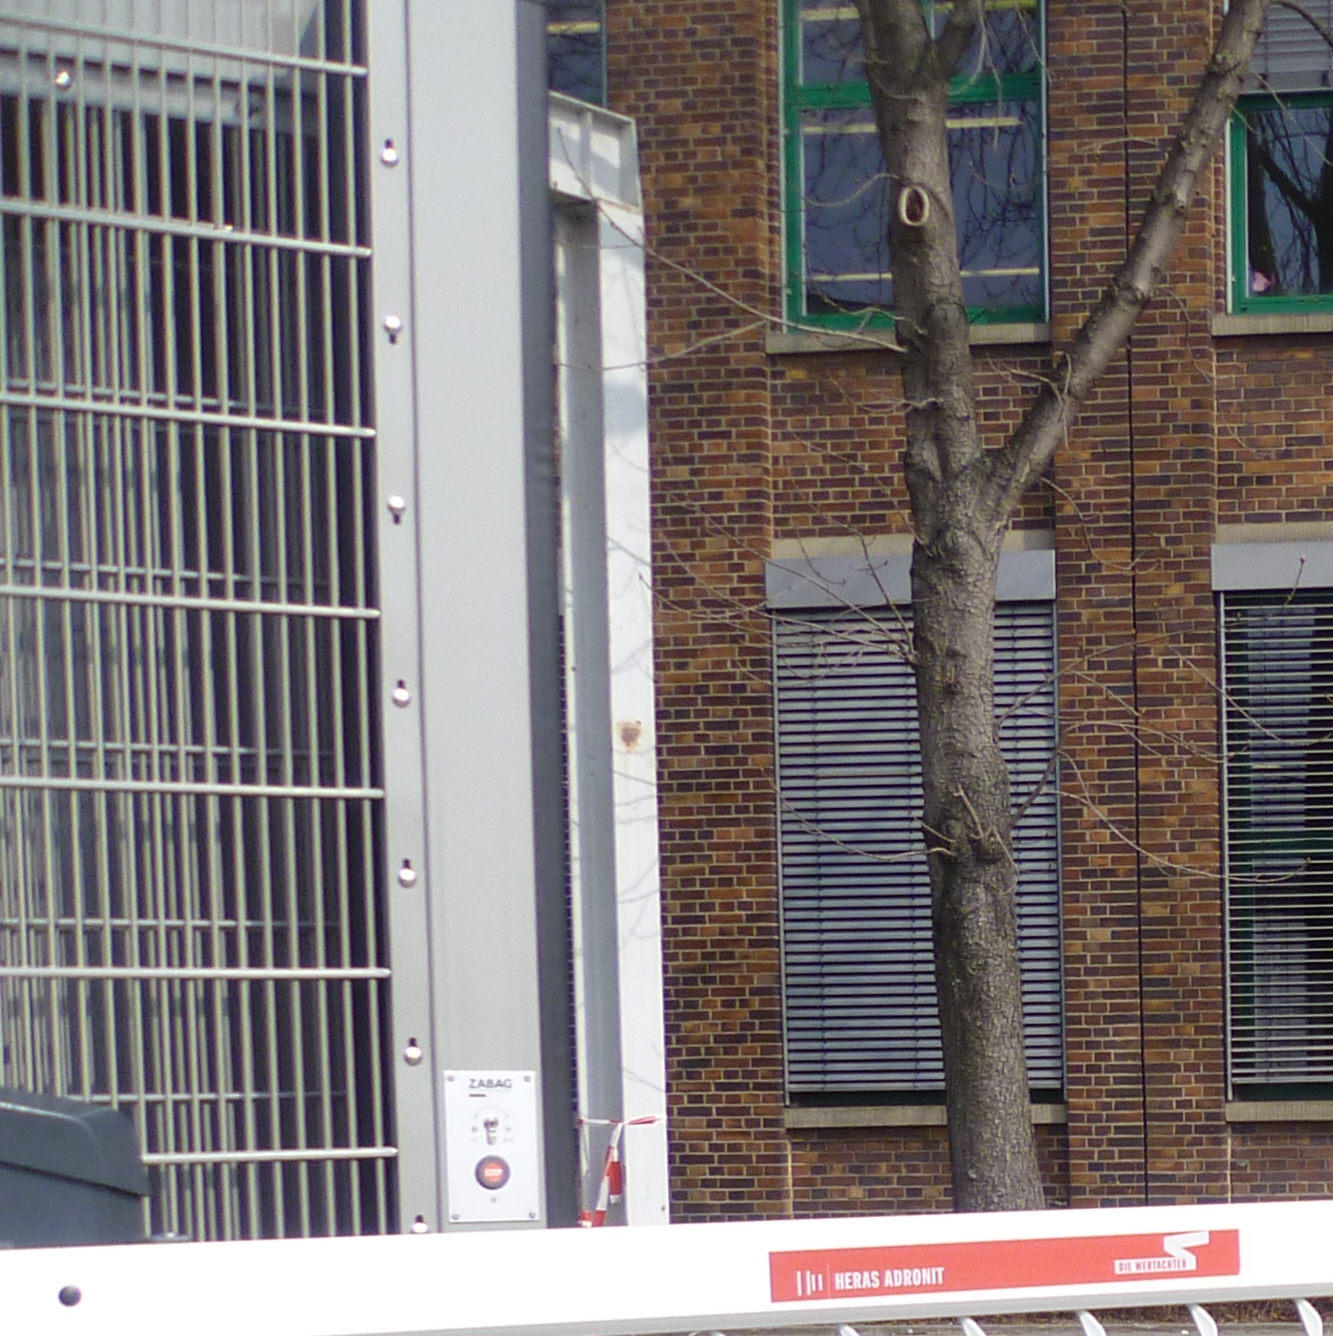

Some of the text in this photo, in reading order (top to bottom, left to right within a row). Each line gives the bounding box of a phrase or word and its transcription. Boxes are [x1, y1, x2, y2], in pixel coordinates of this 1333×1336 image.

[469, 1078, 512, 1089] ZABAG
[1119, 1259, 1187, 1271] DIE WERTACHTER
[835, 1267, 945, 1291] HERAS ADRONIT
